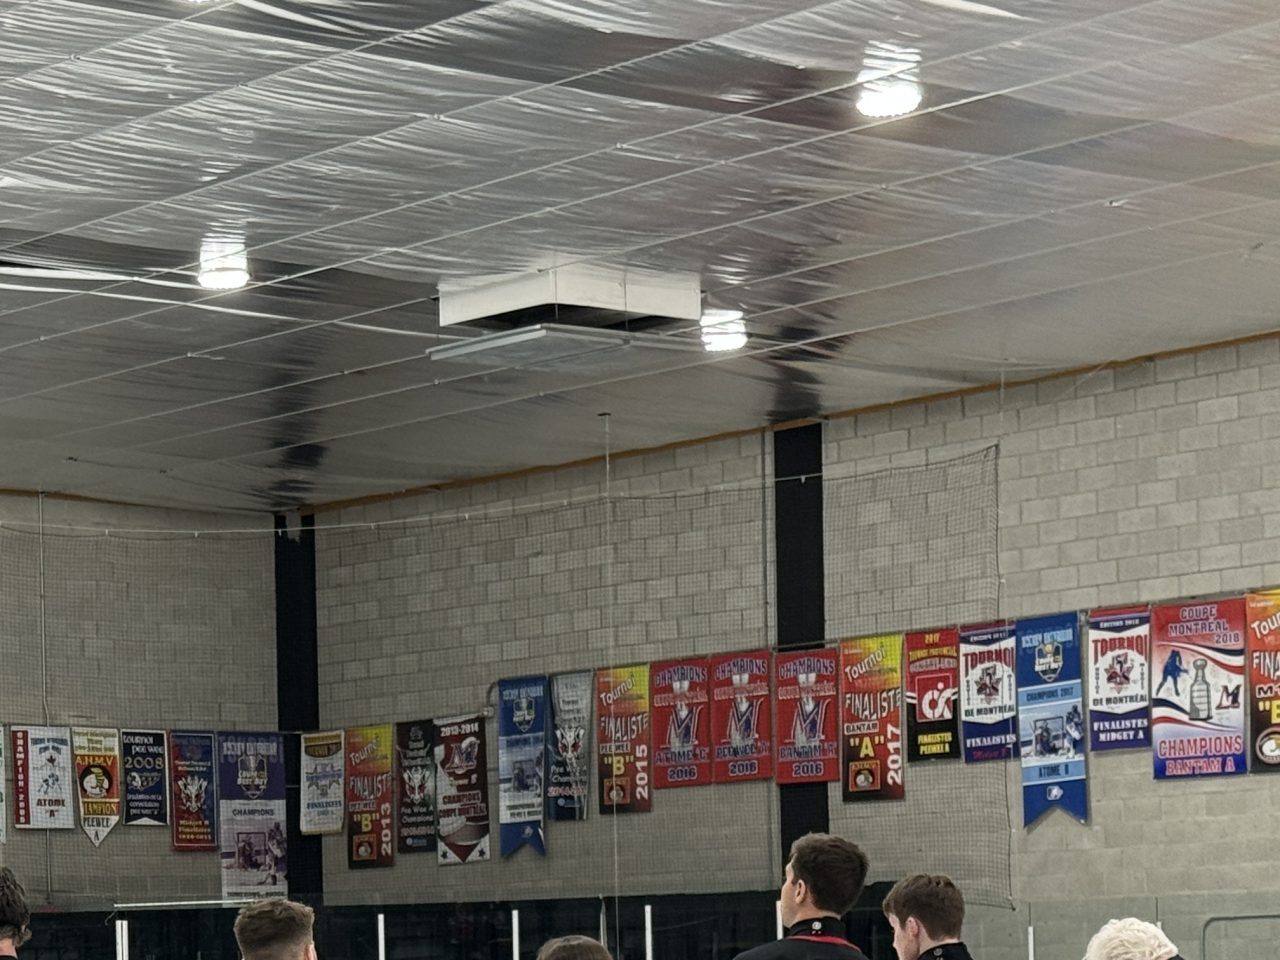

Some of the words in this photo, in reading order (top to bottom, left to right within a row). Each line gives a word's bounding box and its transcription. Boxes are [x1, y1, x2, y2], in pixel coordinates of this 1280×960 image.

[1179, 604, 1217, 620] COUPE
[1169, 617, 1229, 638] MONTRÉAL
[1215, 632, 1241, 645] 2018
[1091, 634, 1149, 665] TOURNOI
[714, 657, 768, 680] CHAMPIONS
[779, 655, 836, 681] CHAMPIONS
[844, 641, 886, 683] Tournoi
[962, 646, 1015, 678] TOURNOI
[655, 664, 707, 688] CHAMPIONS
[844, 687, 902, 721] FINALISTE
[964, 708, 974, 718] DE
[976, 701, 1016, 717] MONTRÉAL
[1093, 698, 1104, 706] DE
[1105, 693, 1148, 706] MONTRÉAL
[600, 712, 649, 741] FINALISTE
[1093, 718, 1149, 731] FINALISTES
[849, 735, 885, 759] "A"
[1099, 731, 1135, 742] MIDGET
[1137, 731, 1145, 740] A
[1158, 735, 1243, 759] CHAMPIONS
[124, 756, 164, 769] 2008
[604, 755, 635, 775] "B"
[886, 722, 902, 787] 2017
[1166, 757, 1222, 775] BANTAM
[1225, 755, 1236, 773] A
[635, 744, 648, 800] 2015
[667, 765, 698, 782] 2016
[728, 760, 759, 776] 2016
[792, 761, 824, 777] 2016
[232, 808, 275, 817] CHAMPIONS
[381, 802, 392, 857] 2013
